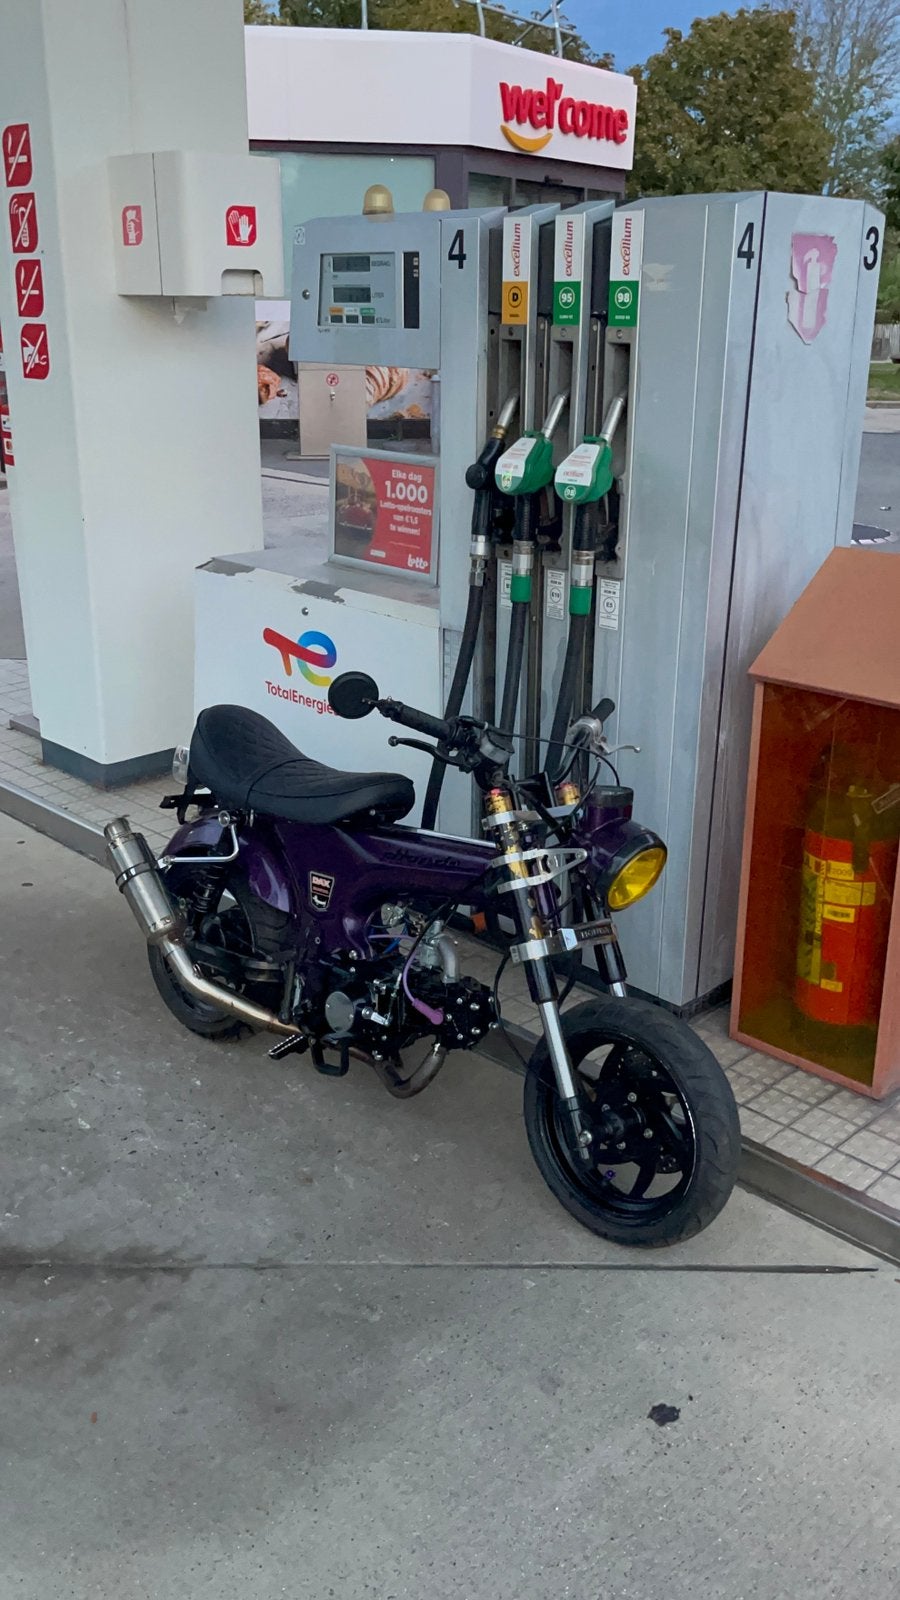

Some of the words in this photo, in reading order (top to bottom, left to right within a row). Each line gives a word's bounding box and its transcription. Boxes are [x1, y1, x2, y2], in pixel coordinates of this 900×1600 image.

[448, 229, 466, 270] 4
[511, 223, 521, 277] excellium
[564, 220, 574, 277] excellium
[621, 217, 632, 276] excellium
[737, 222, 755, 269] 4
[863, 226, 880, 271] 3
[511, 291, 519, 303] D
[560, 293, 574, 304] 95
[616, 292, 630, 303] 98
[391, 469, 407, 480] Elke
[408, 471, 422, 483] dag
[384, 480, 428, 504] 1.000
[389, 523, 397, 532] te
[265, 681, 338, 715] TotalEnergie
[312, 876, 331, 889] DAX
